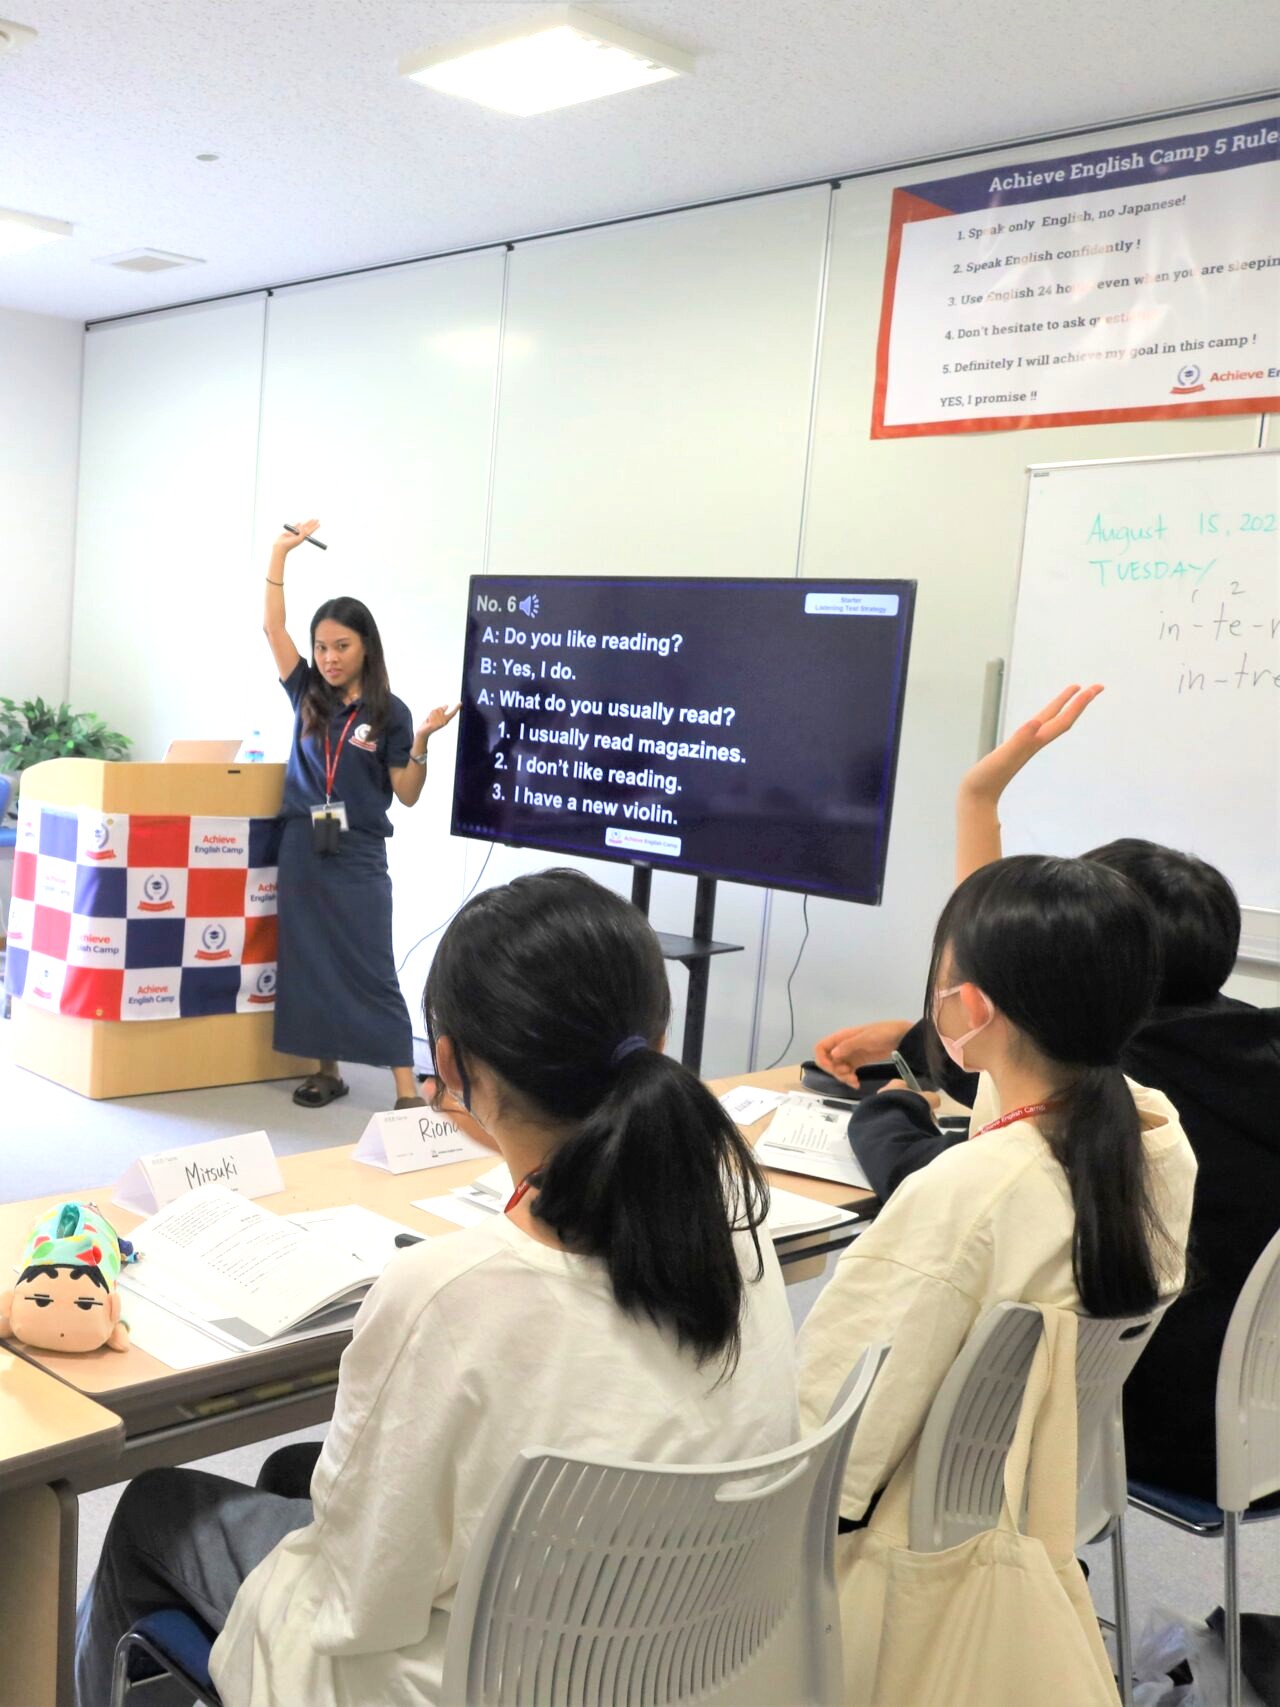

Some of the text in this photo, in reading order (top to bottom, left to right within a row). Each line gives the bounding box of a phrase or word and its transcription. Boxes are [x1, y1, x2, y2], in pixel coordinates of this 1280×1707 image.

[989, 169, 1065, 193] Achieve
[1070, 152, 1144, 179] English
[1150, 144, 1209, 166] Camp
[1214, 138, 1228, 155] 5
[968, 223, 1006, 240] Spak
[1008, 219, 1035, 233] only
[1099, 208, 1115, 219] no
[1118, 194, 1187, 216] Japanese!
[953, 263, 963, 274] 2.
[966, 257, 1002, 274] Speak
[1005, 249, 1054, 266] English
[1057, 240, 1134, 260] confidently
[947, 297, 957, 307] 3.
[961, 294, 984, 305] Use
[987, 287, 1034, 303] English
[1038, 285, 1053, 297] 24
[1097, 277, 1130, 289] even
[1201, 264, 1224, 276] are
[945, 330, 954, 341] 4.
[957, 325, 989, 339] Don't
[992, 321, 1044, 336] hesitate
[1047, 320, 1060, 331] to
[1063, 316, 1086, 329] ask
[942, 364, 952, 375] 5.
[954, 357, 1014, 373] Definitely
[1017, 357, 1023, 368] I
[1026, 354, 1050, 367] will
[1053, 351, 1102, 365] achieve
[1130, 343, 1159, 360] goal
[1162, 342, 1176, 354] in
[1180, 338, 1205, 352] this
[1208, 335, 1248, 350] camp
[1209, 368, 1264, 384] Achieve
[940, 396, 965, 408] YES,
[975, 391, 1027, 407] promise
[1086, 512, 1168, 554] August
[1089, 558, 1218, 587] TUESDAY
[476, 595, 517, 613] No. 6
[482, 626, 683, 657] A: Do you like reading?
[480, 657, 577, 681] B: Yes, I do.
[477, 688, 736, 727] A: What do you usually read?
[498, 721, 747, 764] 1. I usually read magazines.
[494, 752, 682, 795] 2. I don't like reading.
[492, 783, 678, 825] 3. I have a new violin.
[194, 845, 244, 855] English Camp
[202, 835, 237, 844] Achieve
[92, 945, 120, 955] Camp
[128, 994, 175, 1006] English Camp
[137, 984, 169, 995] Achieve
[184, 1155, 238, 1190] Mitsuki
